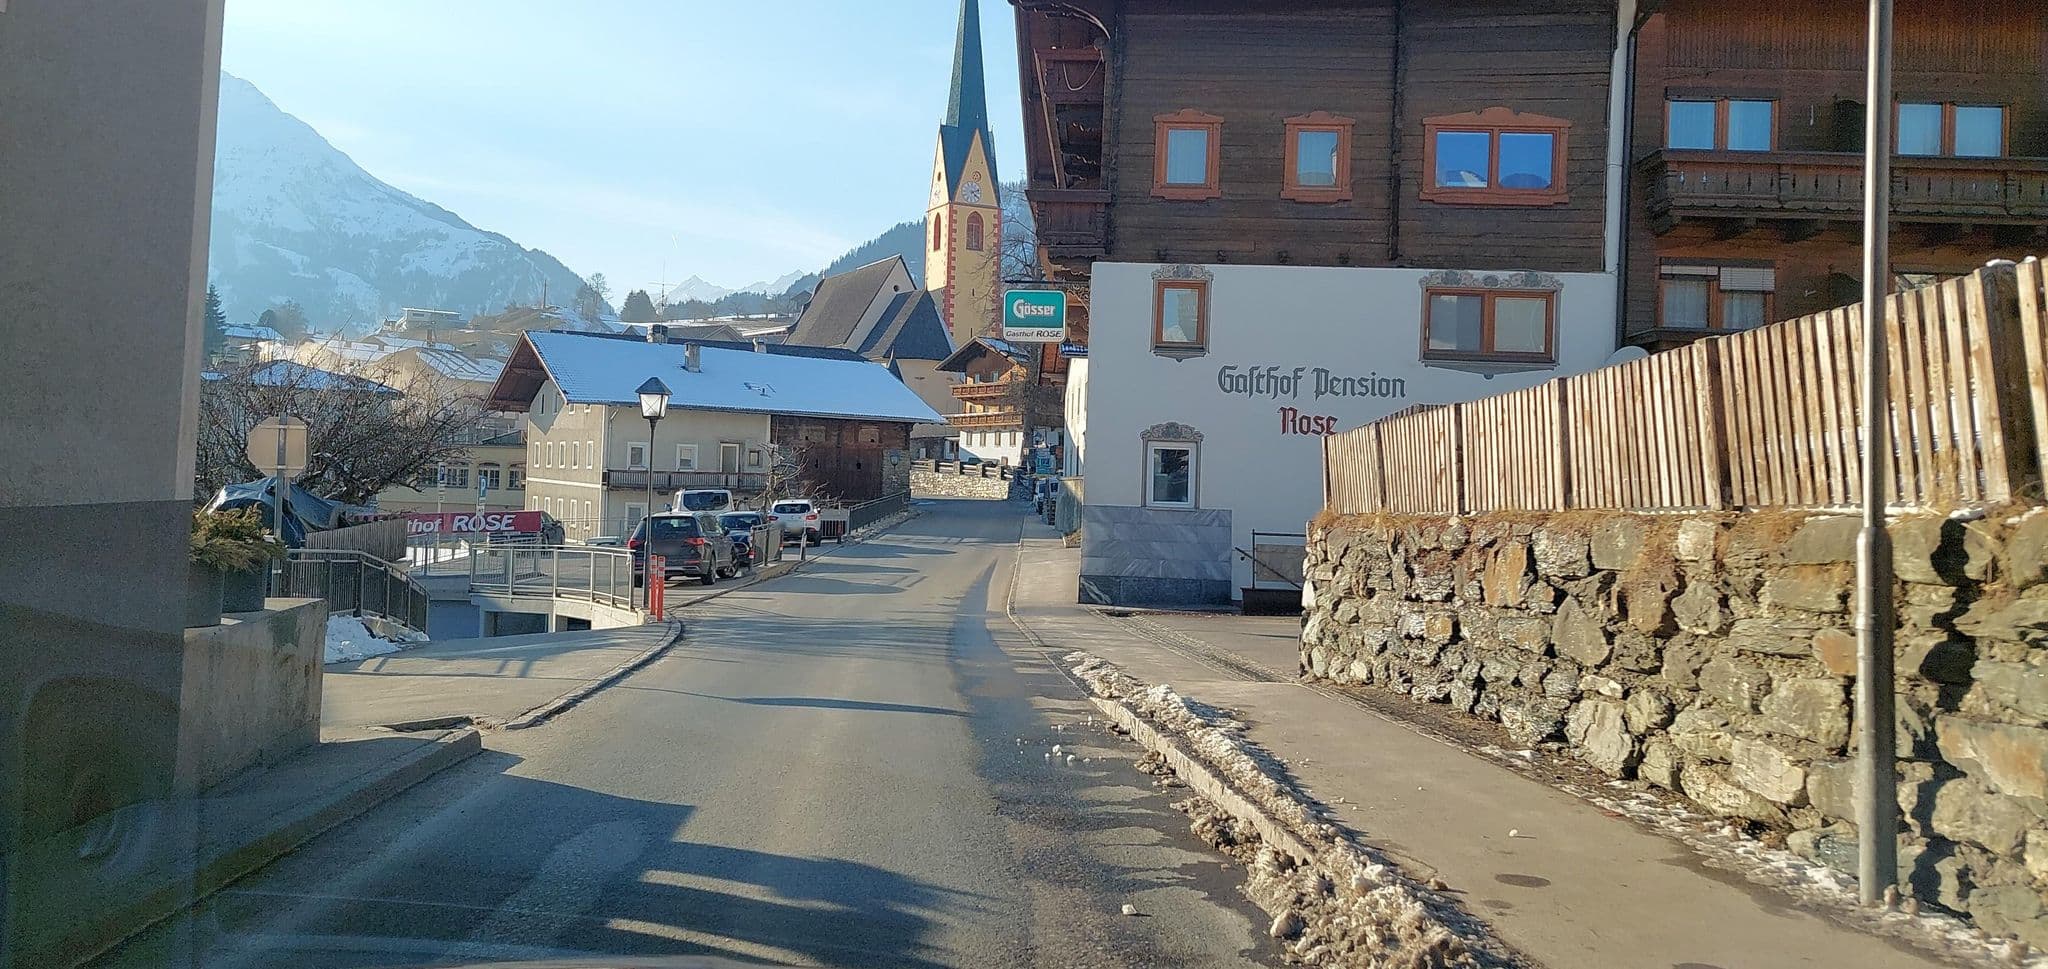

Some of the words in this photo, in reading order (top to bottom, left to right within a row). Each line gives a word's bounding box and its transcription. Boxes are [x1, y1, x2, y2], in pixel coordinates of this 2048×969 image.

[1012, 298, 1056, 319] Gösser
[1036, 330, 1063, 338] ROSE
[1310, 367, 1406, 401] Pension
[1277, 406, 1339, 436] Rose
[480, 478, 487, 497] P
[407, 518, 443, 533] thof
[452, 514, 517, 533] ROSE
